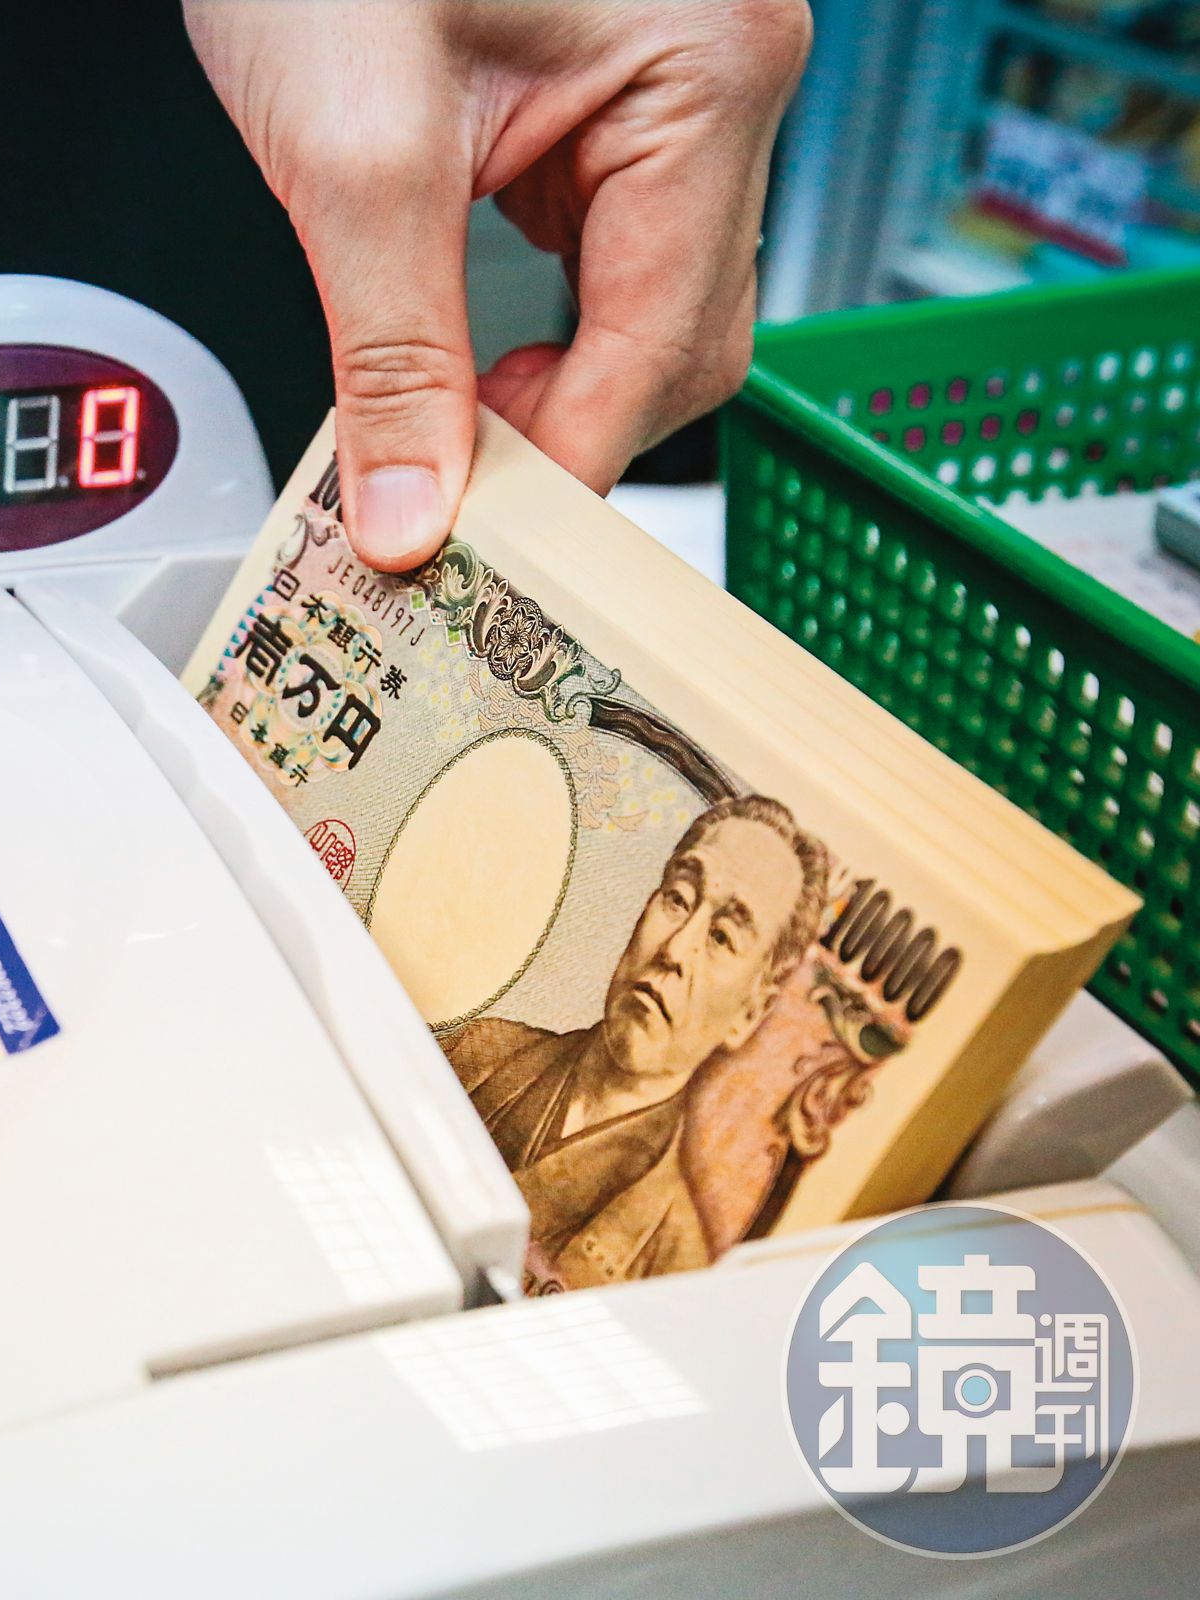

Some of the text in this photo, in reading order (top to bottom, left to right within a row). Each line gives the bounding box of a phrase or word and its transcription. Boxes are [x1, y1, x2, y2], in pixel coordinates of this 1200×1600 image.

[273, 569, 408, 700] 日本銀行券
[327, 556, 425, 646] JE048197J
[230, 701, 310, 787] 日本銀行
[820, 877, 963, 1023] 10000
